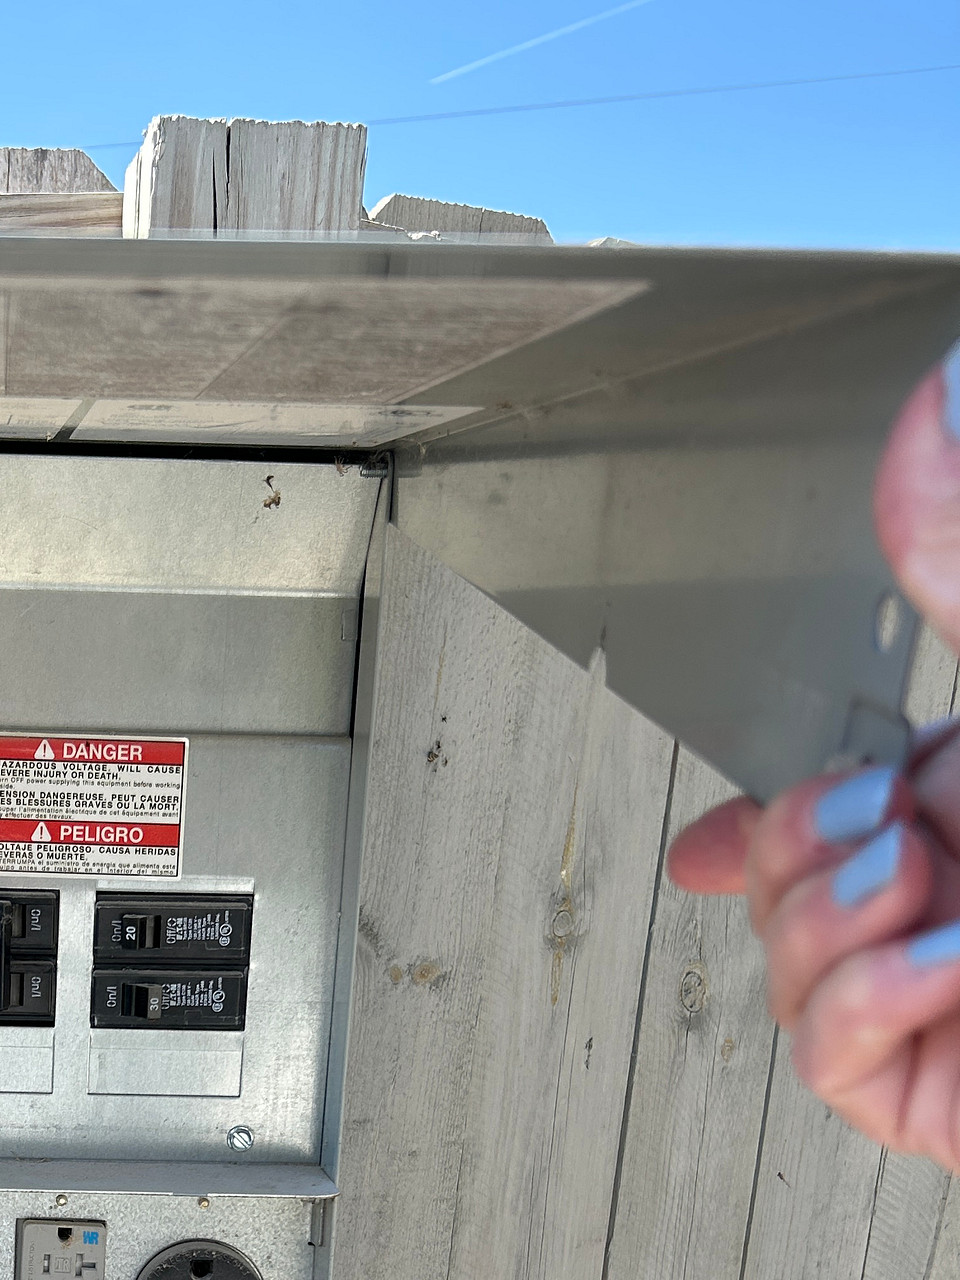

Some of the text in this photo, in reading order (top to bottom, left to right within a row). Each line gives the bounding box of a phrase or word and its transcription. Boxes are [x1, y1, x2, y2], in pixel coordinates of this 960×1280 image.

[63, 742, 143, 761] DANGER
[34, 770, 68, 778] INJURY
[71, 771, 84, 779] OR
[117, 765, 141, 773] WILL
[147, 766, 181, 774] CAUSE
[16, 799, 70, 807] BLESSURES
[75, 800, 113, 809] GRAVES
[134, 802, 145, 810] LA
[140, 795, 179, 803] CAUSER
[60, 825, 144, 843] PELIGRO
[99, 847, 130, 855] CAUSA
[135, 848, 176, 856] HERIDAS
[126, 926, 136, 940] 20
[150, 998, 159, 1011] 30
[82, 1231, 99, 1245] WR
